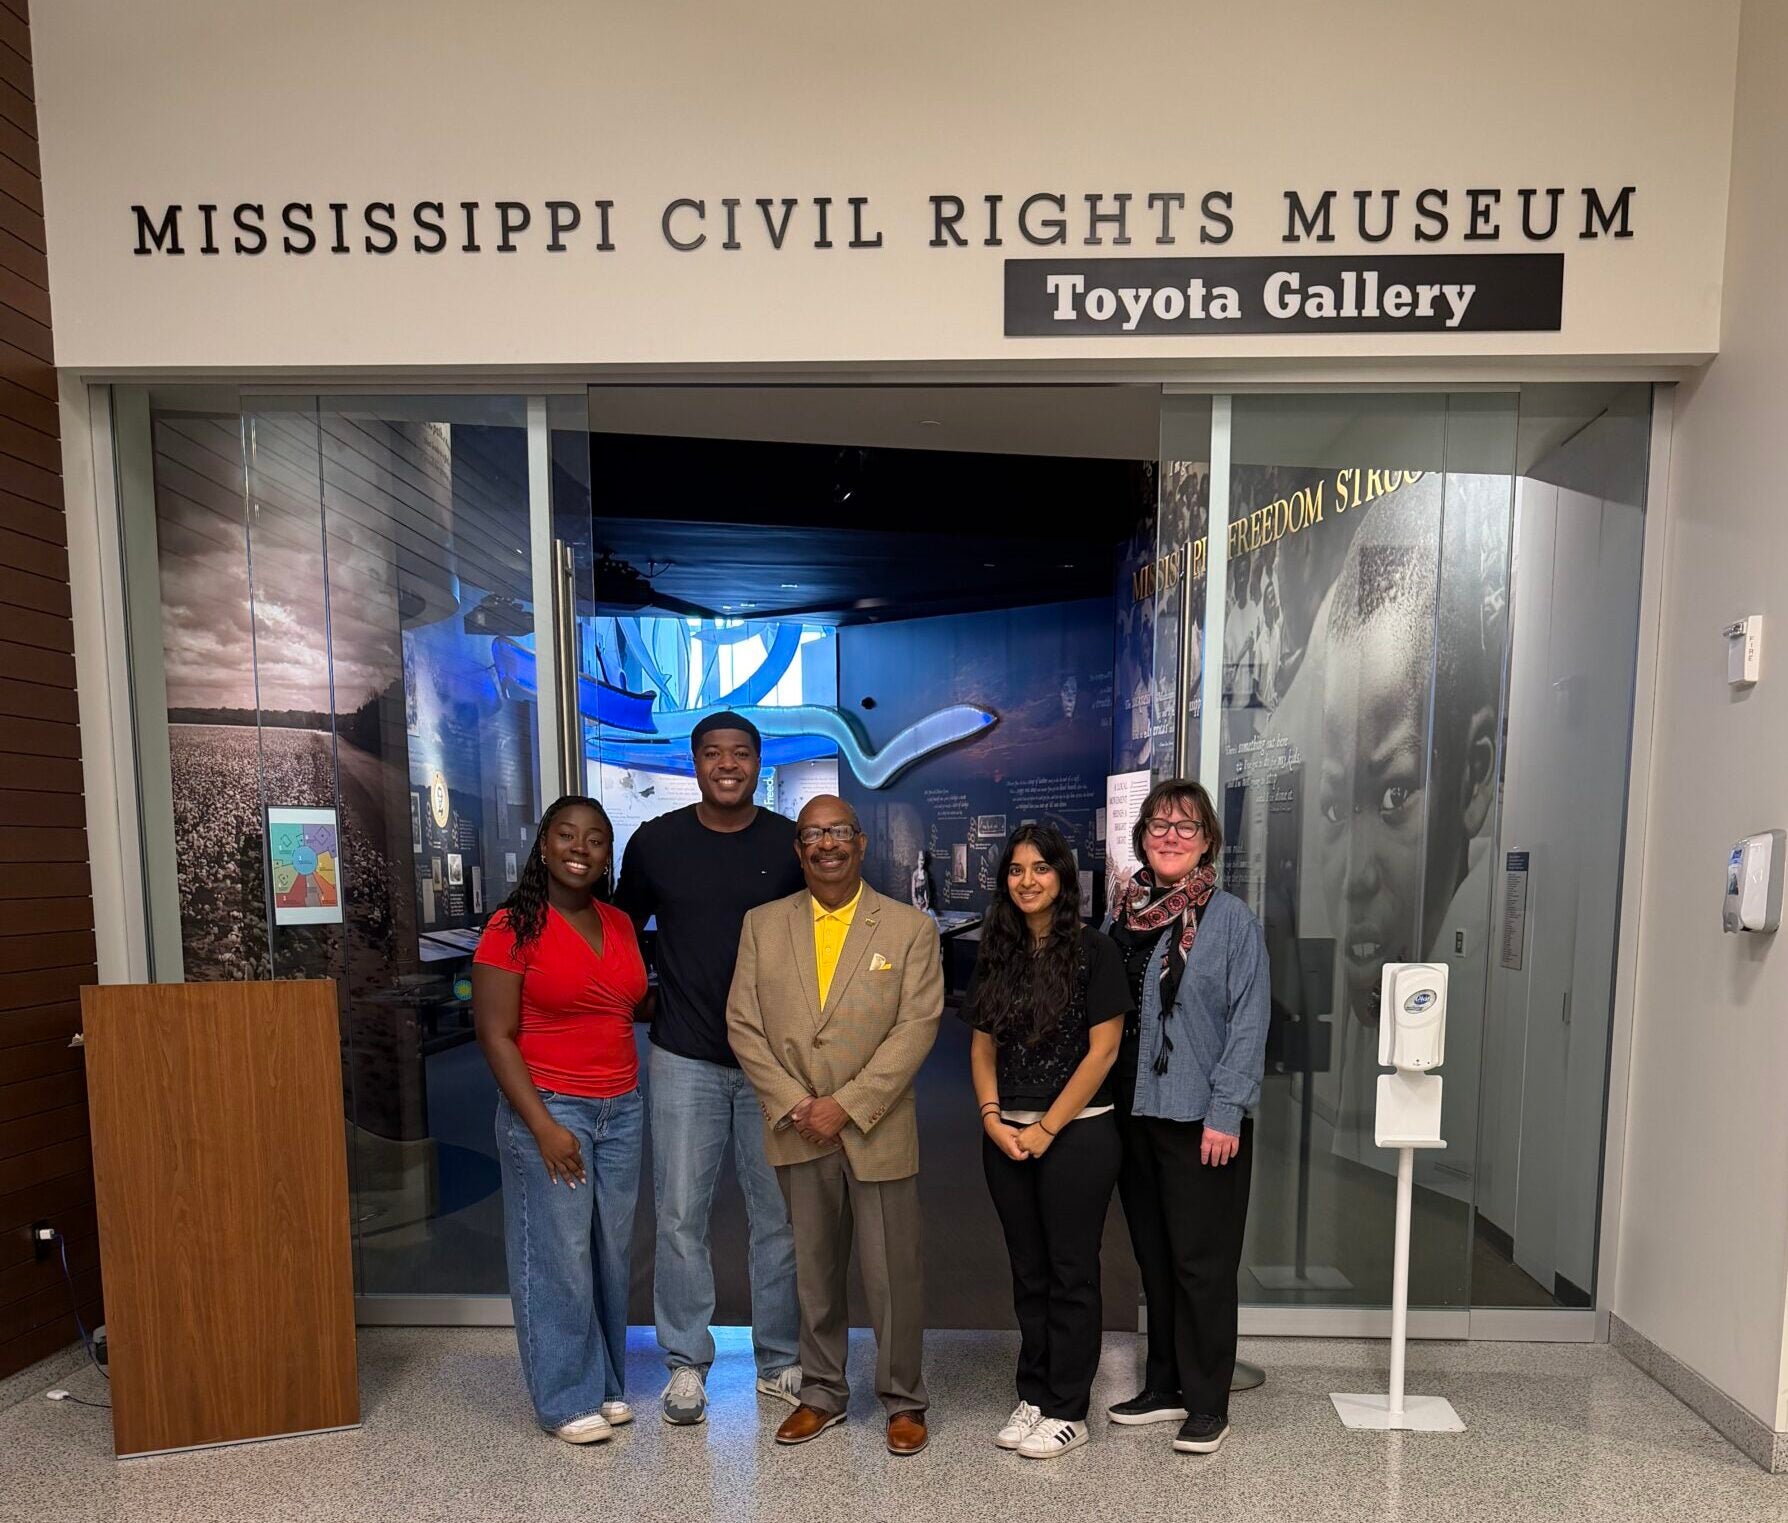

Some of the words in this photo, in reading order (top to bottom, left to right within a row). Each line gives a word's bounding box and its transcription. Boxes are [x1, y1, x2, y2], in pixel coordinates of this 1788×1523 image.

[130, 198, 616, 256] MISSISSIPPI
[661, 197, 883, 252] CIVIL
[928, 190, 1234, 248] RIGHTS
[1282, 186, 1637, 244] MUSEUM
[1046, 273, 1242, 332] Toyota
[1263, 270, 1476, 328] Gallery
[1132, 536, 1207, 602] MISSISPI
[1227, 479, 1325, 560] FREEDOM
